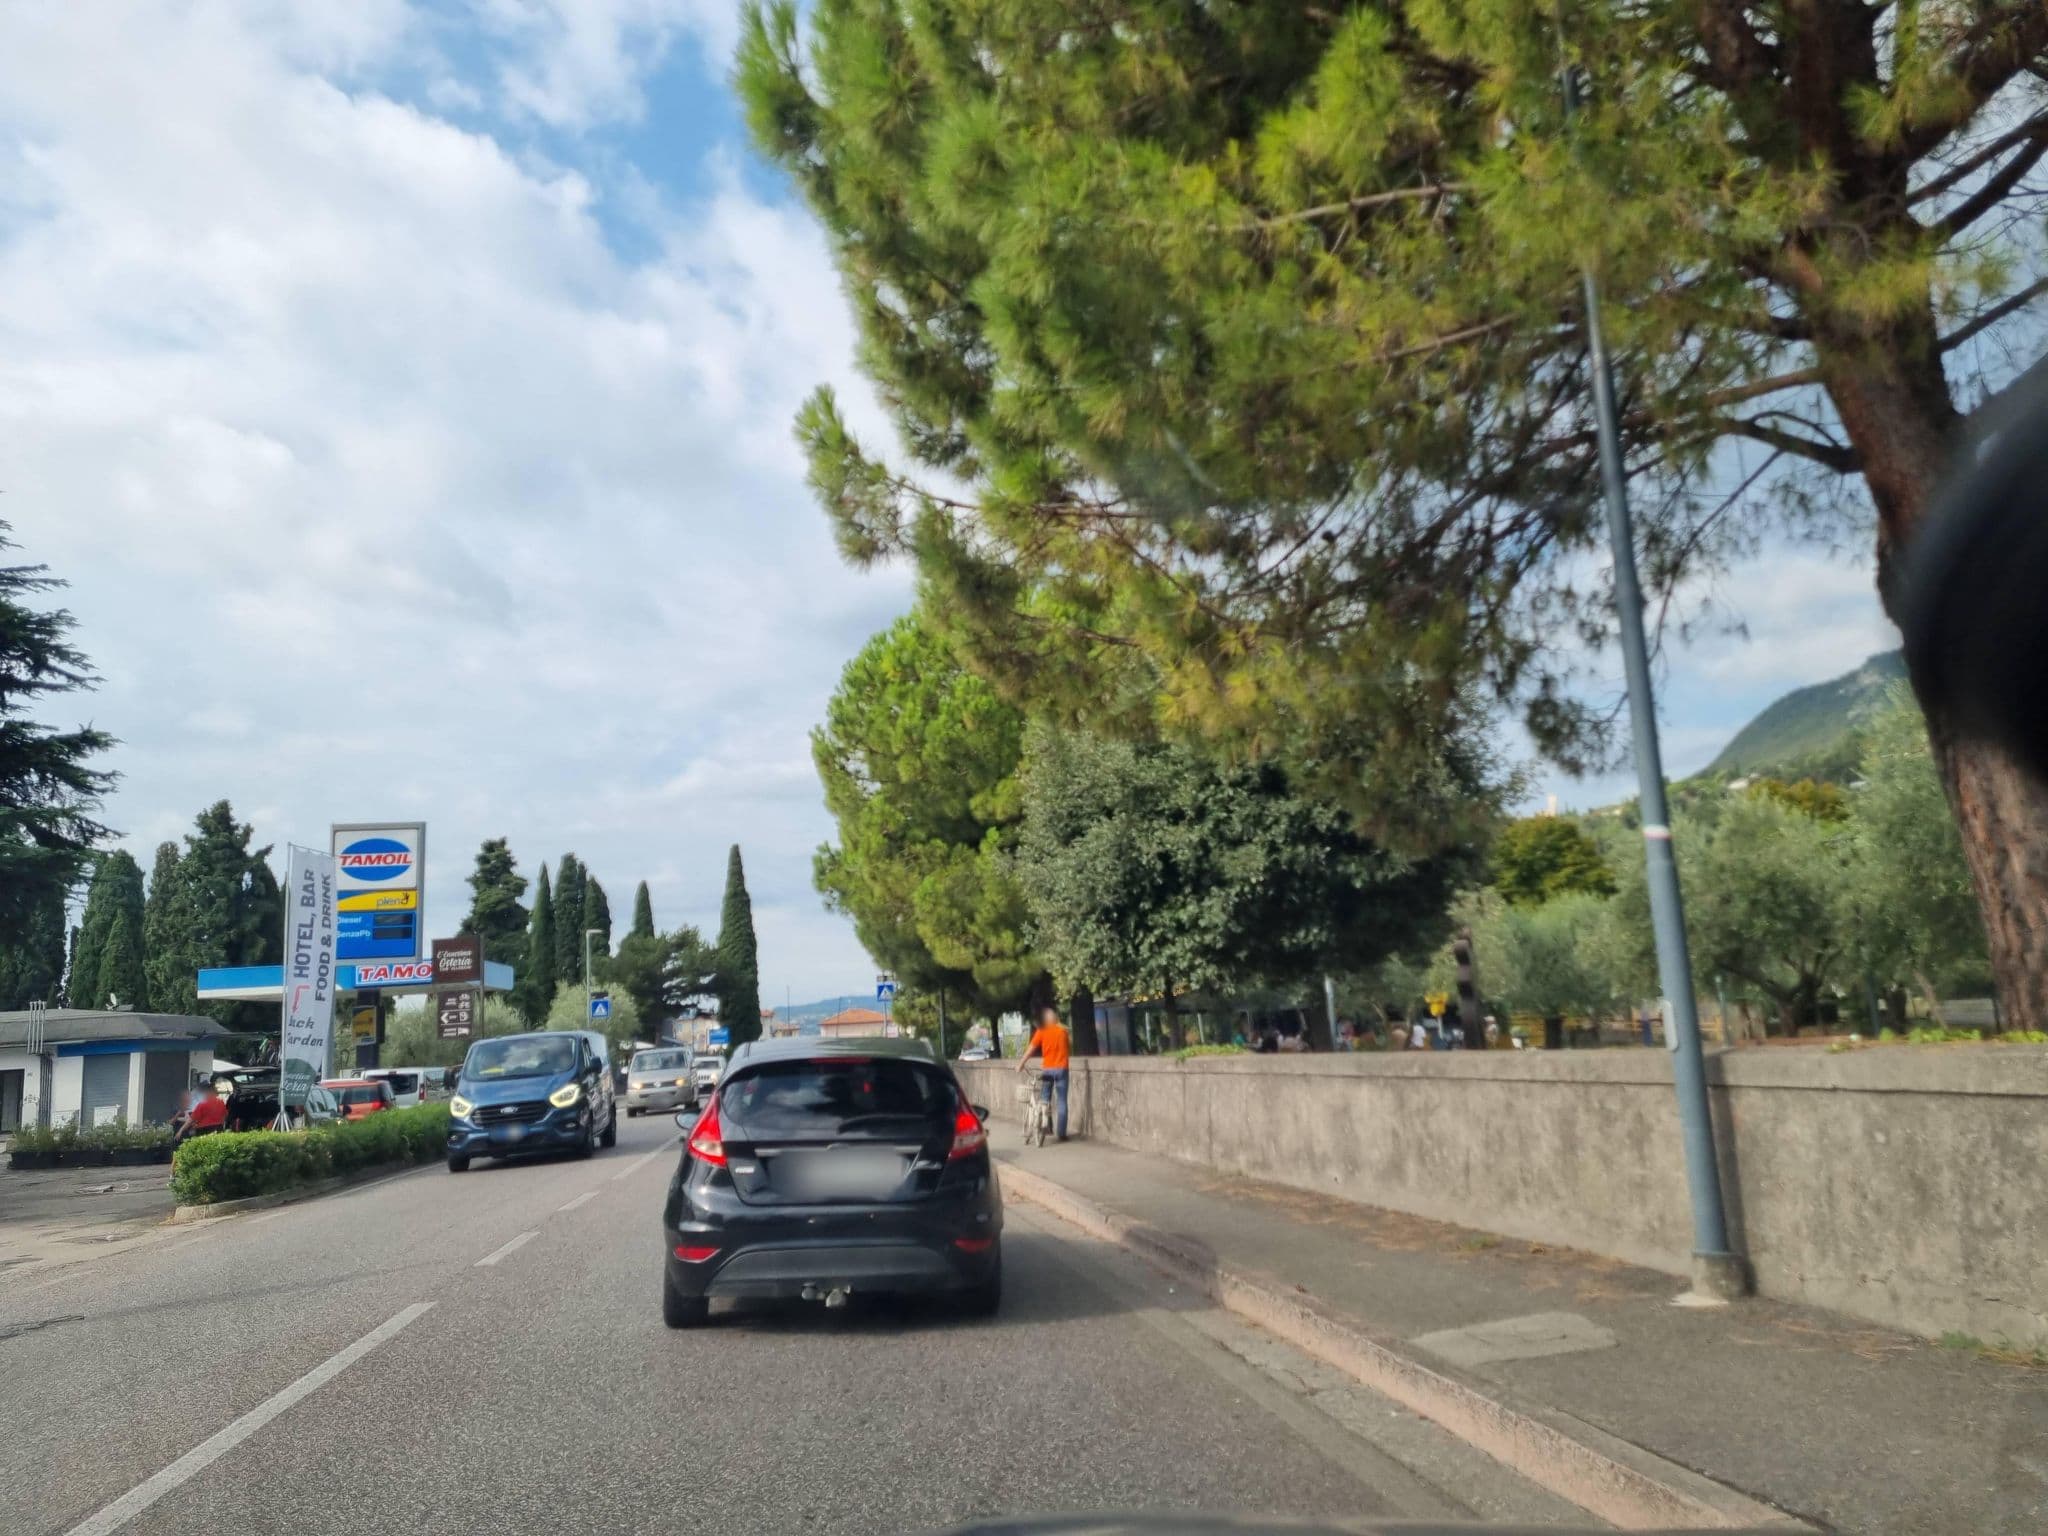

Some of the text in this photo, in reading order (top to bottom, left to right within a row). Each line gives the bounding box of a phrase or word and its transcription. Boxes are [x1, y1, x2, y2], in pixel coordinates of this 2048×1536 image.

[338, 853, 412, 866] TAMOIL
[293, 869, 317, 978] HOTEL, BAR
[315, 873, 332, 1001] FOOD & DRINK
[360, 964, 433, 981] TAMO
